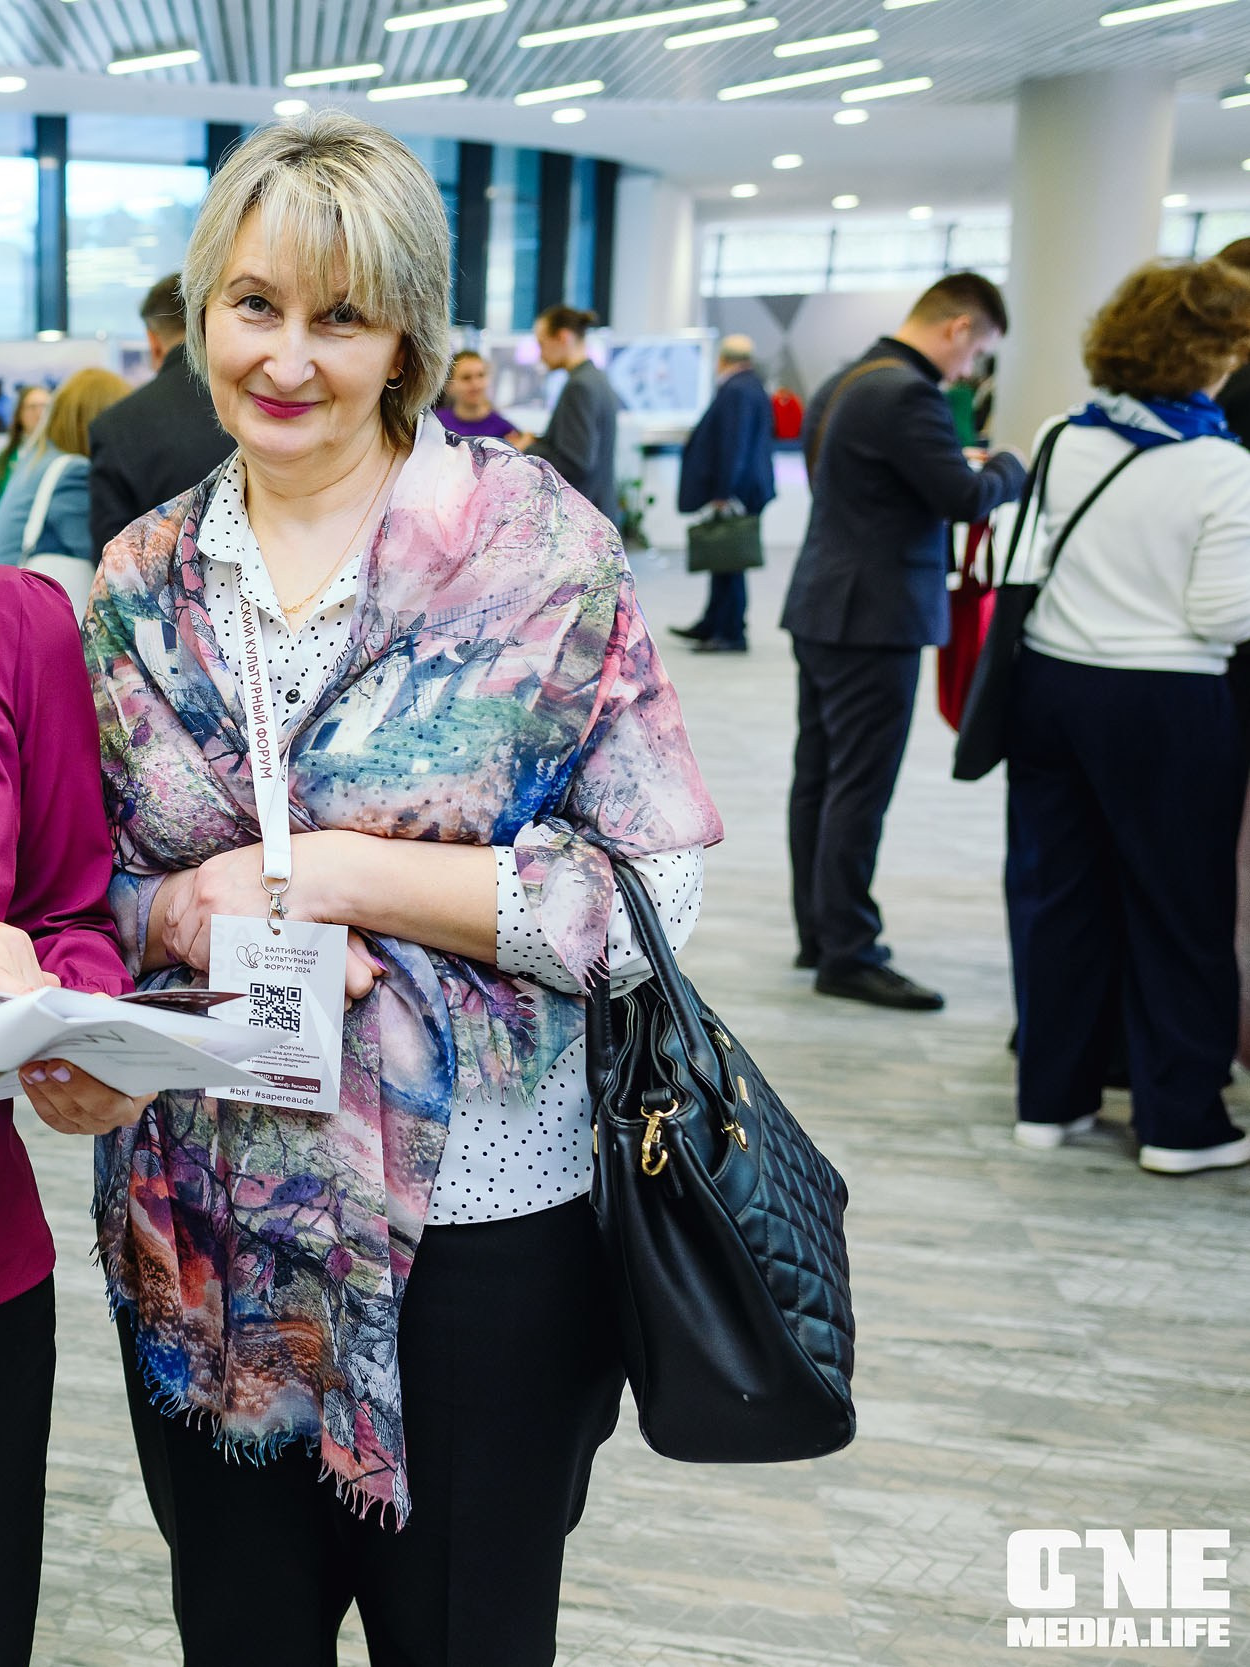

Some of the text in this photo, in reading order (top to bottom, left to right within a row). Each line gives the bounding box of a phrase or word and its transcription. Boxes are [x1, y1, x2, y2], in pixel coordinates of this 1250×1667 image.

[245, 638, 269, 727] КУЛЬТУРНЫЙ
[255, 728, 273, 779] ФОРУМ
[264, 946, 319, 957] БАЛТИЙСКИЙ
[264, 955, 316, 965] КУЛЬТУРНЫЙ
[264, 963, 293, 972] ФОРУМ
[279, 1044, 304, 1052] ФОРУМА
[229, 1087, 314, 1105] #bkf #sapereaude
